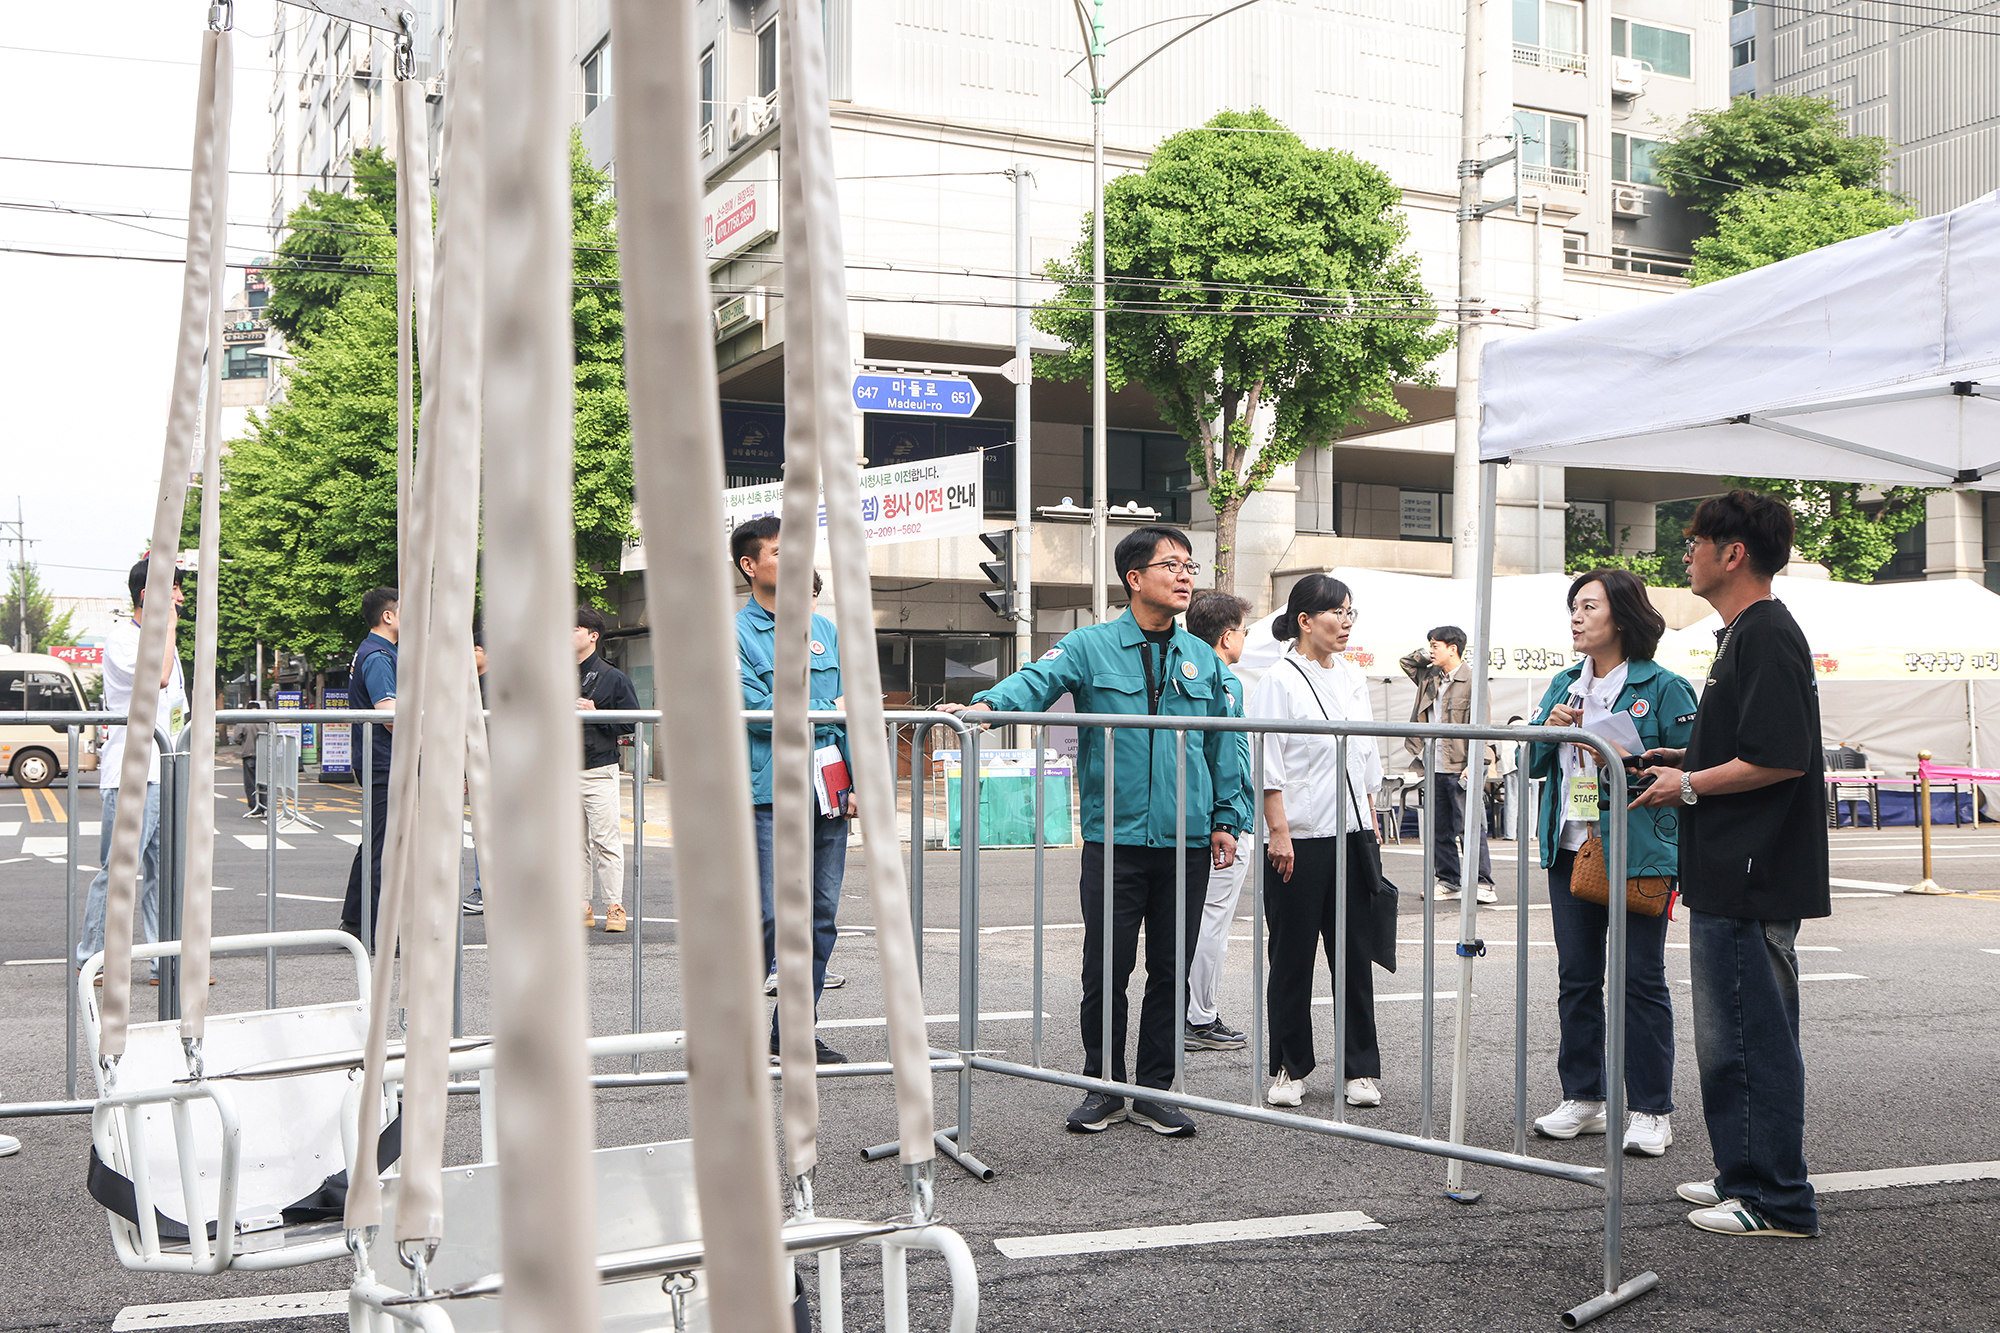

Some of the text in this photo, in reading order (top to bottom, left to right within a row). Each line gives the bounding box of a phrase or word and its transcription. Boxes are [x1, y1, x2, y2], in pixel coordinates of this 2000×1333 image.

[857, 386, 879, 399] 647
[892, 379, 938, 397] 마들로
[887, 398, 943, 411] Madeul-ro
[951, 391, 971, 404] 651
[730, 493, 746, 507] 청사
[746, 490, 762, 505] 신축
[858, 473, 892, 489] 시청사로
[894, 465, 940, 484] 이전합니다.
[883, 492, 911, 519] 청사
[915, 487, 943, 514] 이전
[947, 483, 976, 510] 안내
[1514, 648, 1564, 670] 맛있게
[1904, 652, 1998, 672] 반짝공방 키링
[1573, 794, 1598, 803] STAFF
